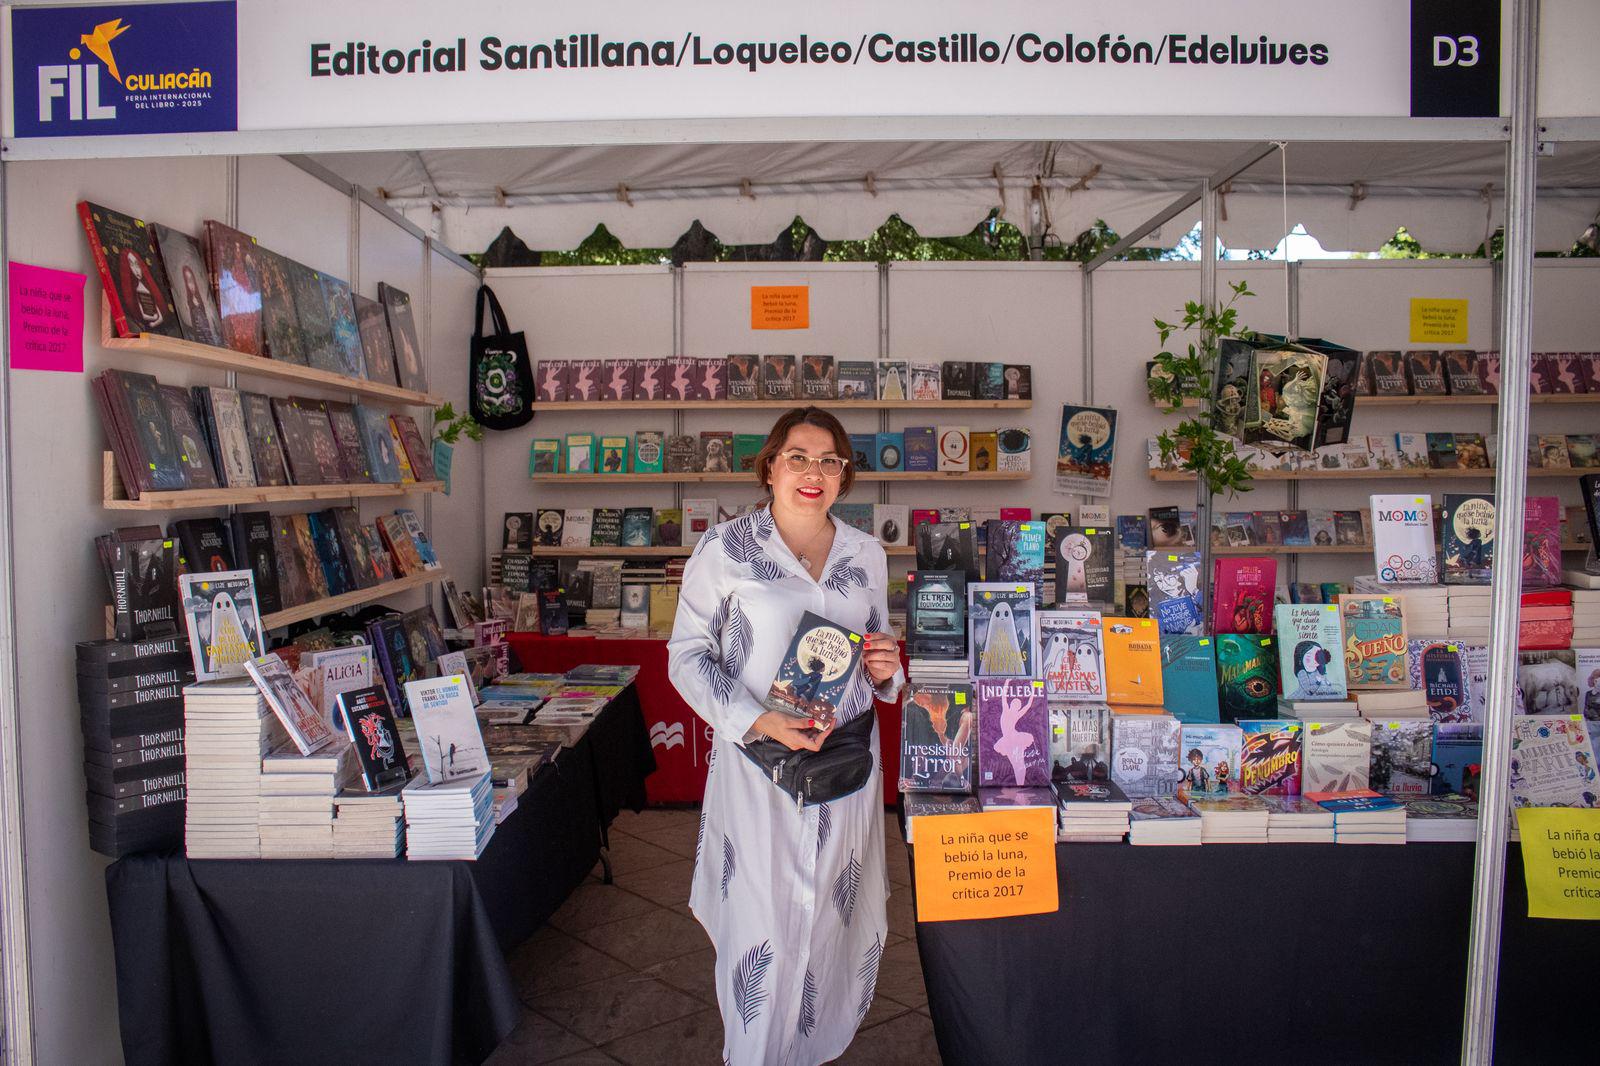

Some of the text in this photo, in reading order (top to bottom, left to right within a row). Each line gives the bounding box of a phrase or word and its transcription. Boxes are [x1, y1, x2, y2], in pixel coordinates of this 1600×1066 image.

[311, 38, 467, 77] Editorial
[1432, 36, 1480, 67] D3
[38, 64, 117, 121] FIL
[149, 92, 212, 101] INTERNACIONAL
[20, 287, 28, 295] La
[1379, 510, 1428, 522] MOMO
[114, 569, 128, 615] THORNHILL
[933, 594, 952, 602] TREN
[134, 605, 174, 625] THORNHILL
[1300, 608, 1320, 617] herida
[1303, 616, 1320, 624] duele
[815, 629, 845, 646] La niña
[1298, 631, 1319, 640] siente
[134, 640, 185, 658] THORNHILL
[206, 641, 257, 657] FANTASMAS
[805, 635, 849, 659] que se bebió
[809, 643, 840, 663] la luna
[1345, 633, 1408, 678] SUEÑO
[135, 669, 180, 688] THORNHILL
[1047, 671, 1097, 681] FANTASMAS
[134, 685, 180, 704] THORNHILL
[981, 684, 1046, 701] INDELEBLE
[1431, 688, 1459, 696] ENDE
[1072, 720, 1099, 733] ALMAS
[140, 728, 185, 747] THORNHILL
[1072, 732, 1099, 743] MUERTAS
[140, 743, 186, 762] THORNHILL
[904, 742, 969, 757] Irresistible
[1520, 742, 1569, 760] MUJERES
[911, 757, 961, 779] Error
[1122, 764, 1141, 772] DAHL
[142, 772, 187, 792] THORNHILL
[1392, 781, 1422, 792] La lluvia
[142, 788, 187, 807] THORNHILL
[941, 831, 1029, 846] La niña que se
[1547, 829, 1560, 840] La
[1564, 829, 1590, 841] niña
[944, 849, 1027, 863] bebió la luna,
[1552, 847, 1587, 859] bebió
[948, 866, 1026, 881] Premio de la
[952, 885, 1023, 900] crítica 2017
